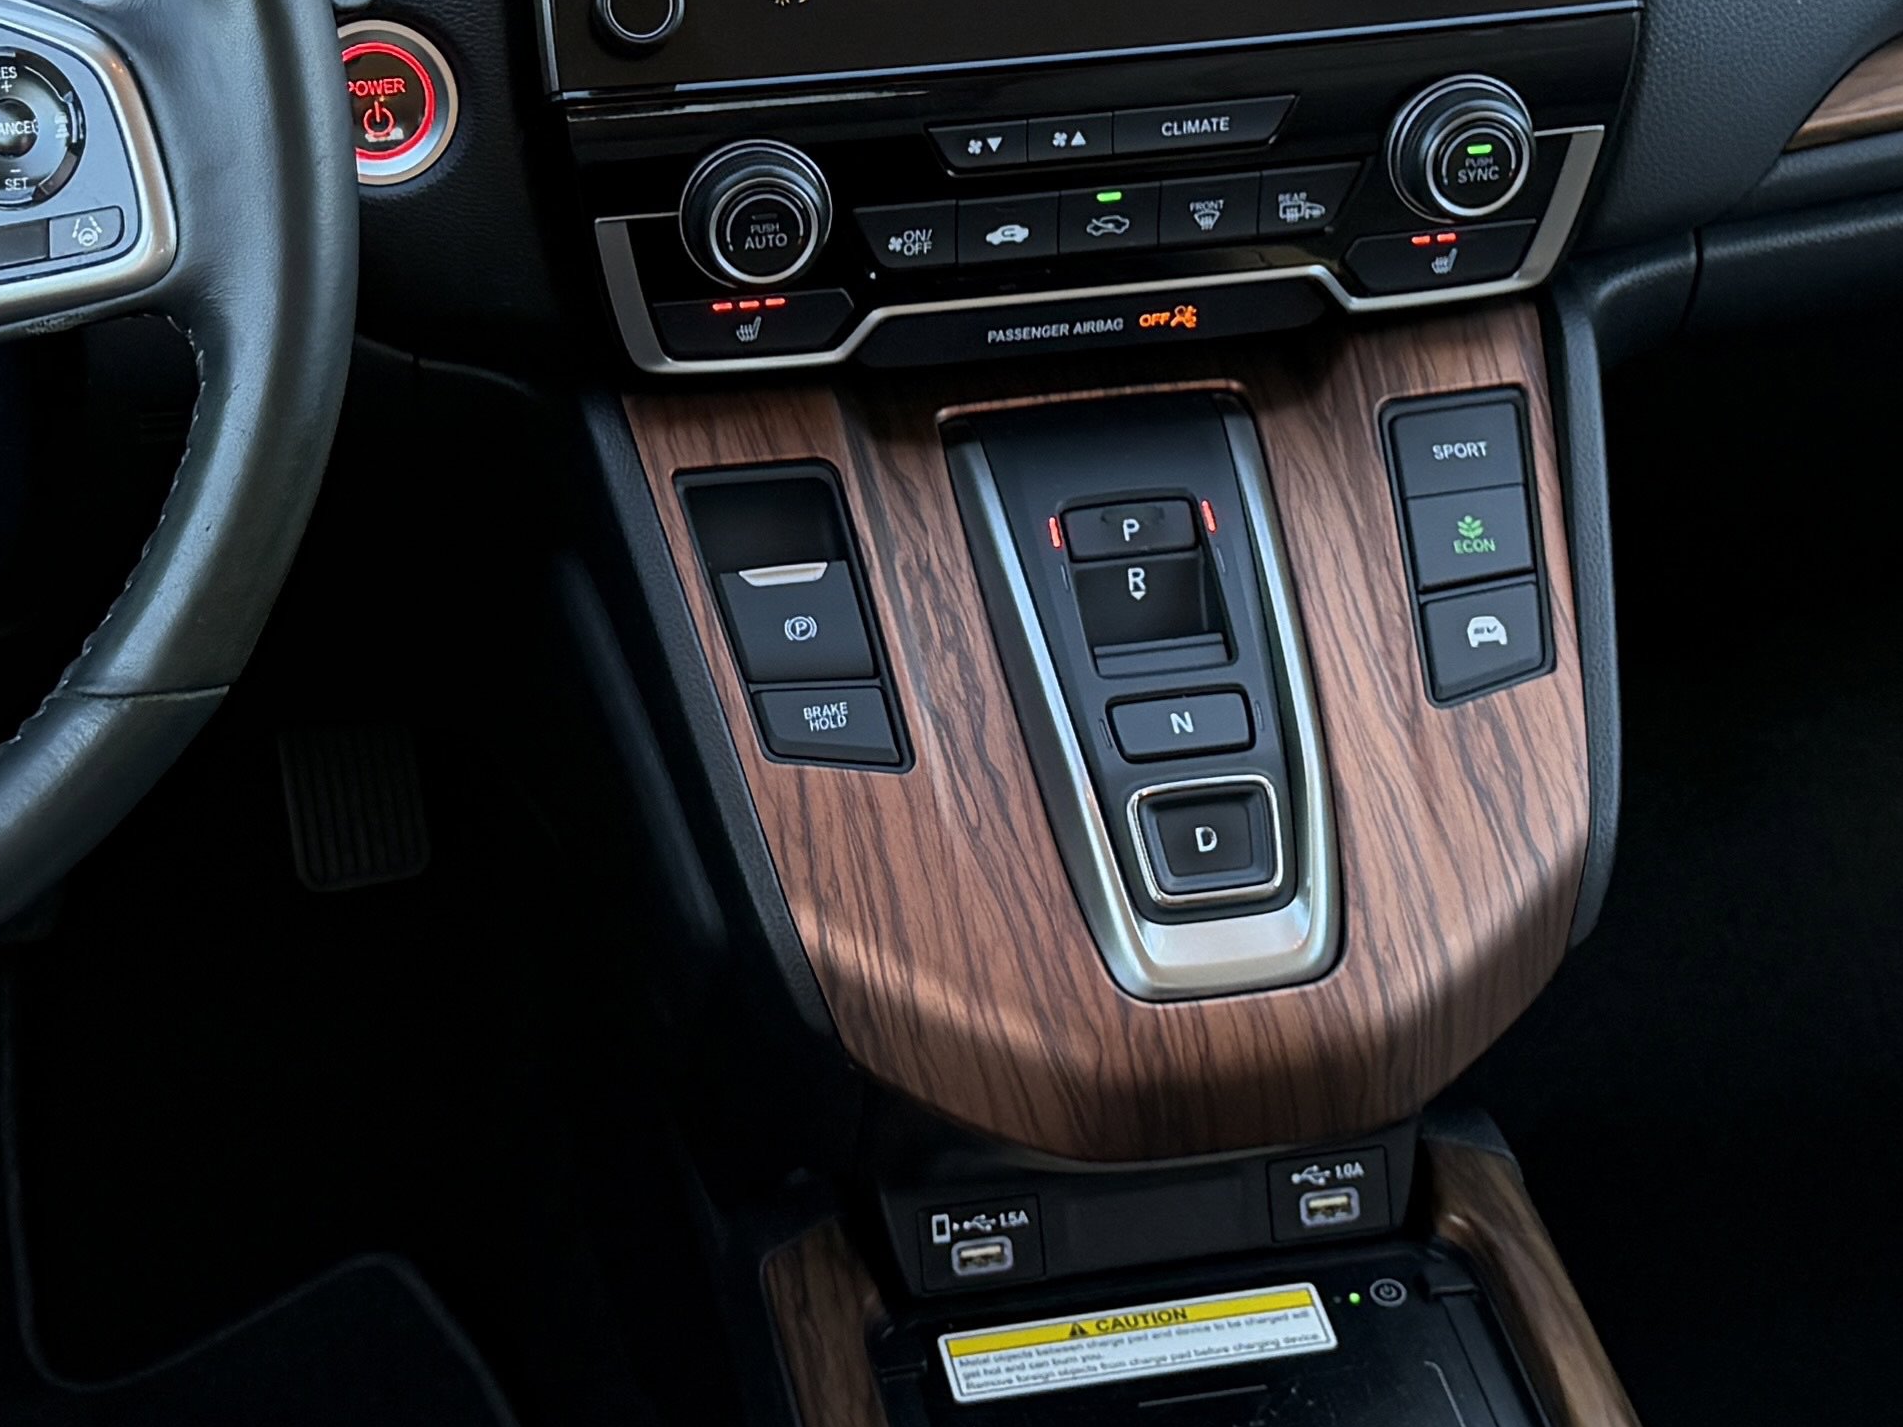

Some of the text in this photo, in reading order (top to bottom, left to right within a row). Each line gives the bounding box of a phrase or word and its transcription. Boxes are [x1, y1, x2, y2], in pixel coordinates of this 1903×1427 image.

[1161, 117, 1230, 137] CLIMATE
[4, 177, 29, 191] SET
[1457, 165, 1500, 184] SYNC
[1190, 199, 1224, 212] FRONT
[750, 223, 780, 235] PUSH
[744, 233, 788, 250] AUTO
[903, 241, 933, 256] OFF
[987, 312, 1171, 343] PASSENGER AIRBAG OFF
[1432, 441, 1488, 460] SPORT
[1122, 518, 1140, 542] P
[1453, 539, 1496, 555] ECON
[1127, 567, 1146, 592] R
[803, 701, 849, 720] BRAKE
[809, 715, 847, 732] HOLD
[1169, 711, 1194, 734] N
[1195, 826, 1217, 852] D
[1095, 1307, 1188, 1333] CAUTION
